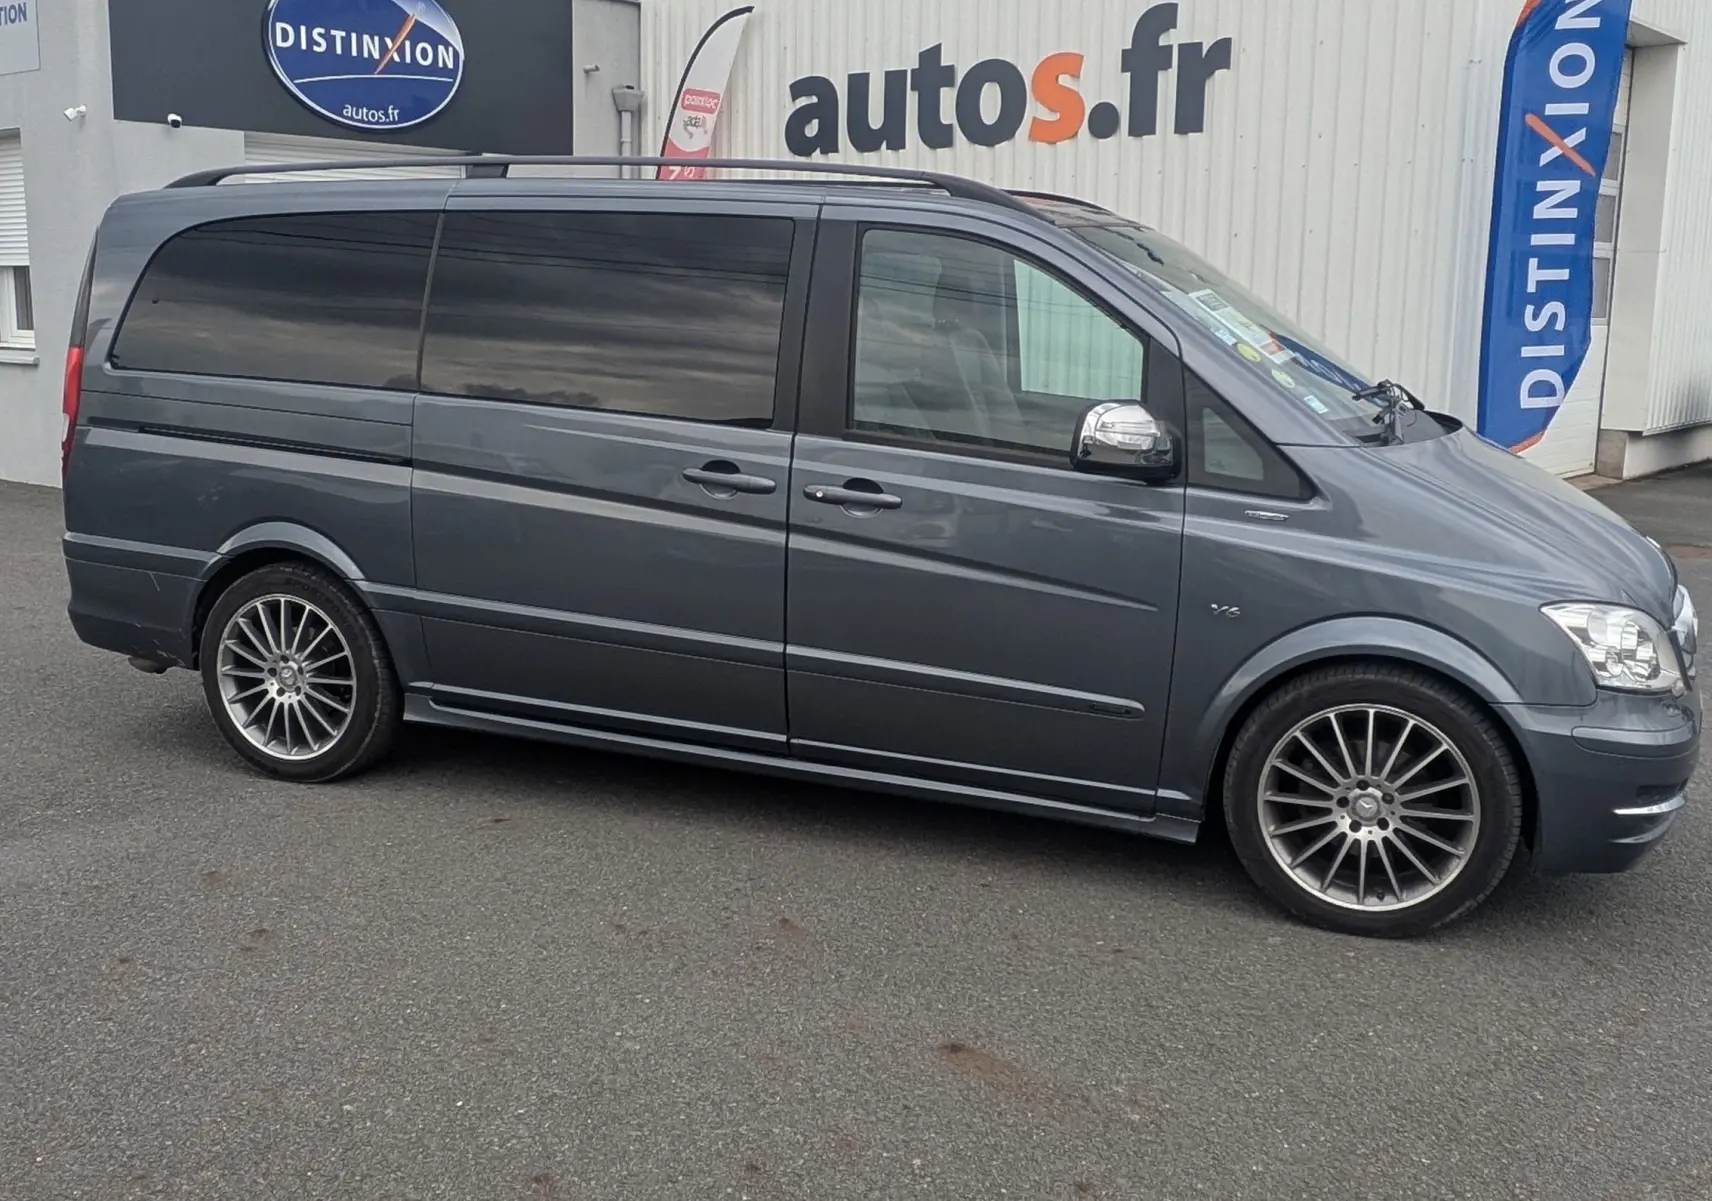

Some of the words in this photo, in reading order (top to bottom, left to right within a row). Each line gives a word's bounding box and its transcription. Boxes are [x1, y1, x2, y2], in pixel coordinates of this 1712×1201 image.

[275, 18, 454, 72] DISTINXION
[784, 2, 1232, 157] autos.fr
[342, 104, 399, 122] autos.fr
[1519, 0, 1602, 409] DISTINXION
